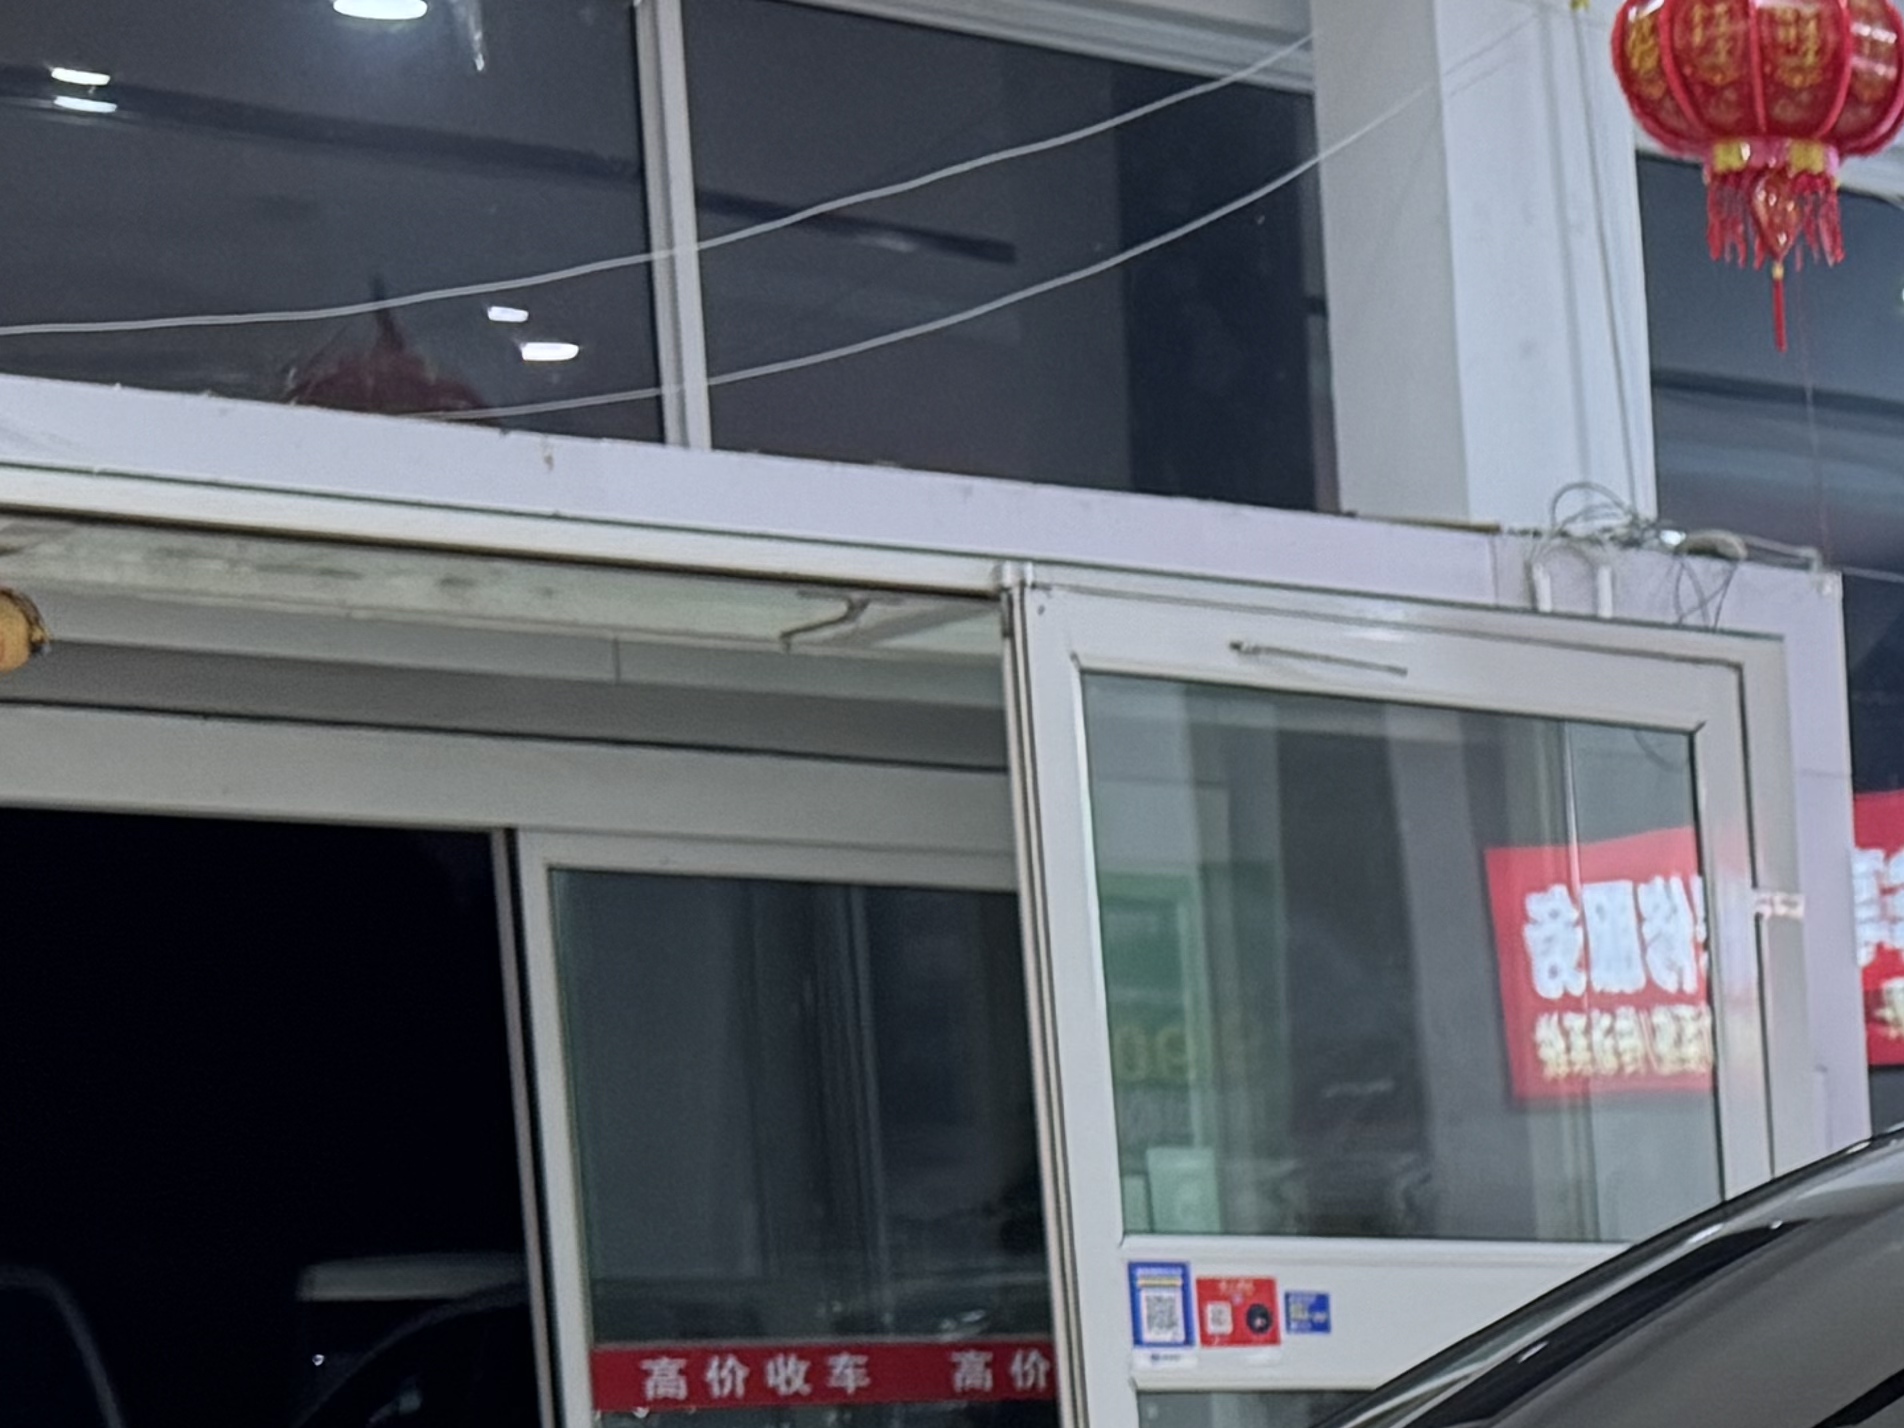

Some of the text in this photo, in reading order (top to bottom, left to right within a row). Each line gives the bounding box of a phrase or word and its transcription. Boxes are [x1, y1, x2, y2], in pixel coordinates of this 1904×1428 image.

[639, 1349, 1048, 1401] 高价收车 高价
